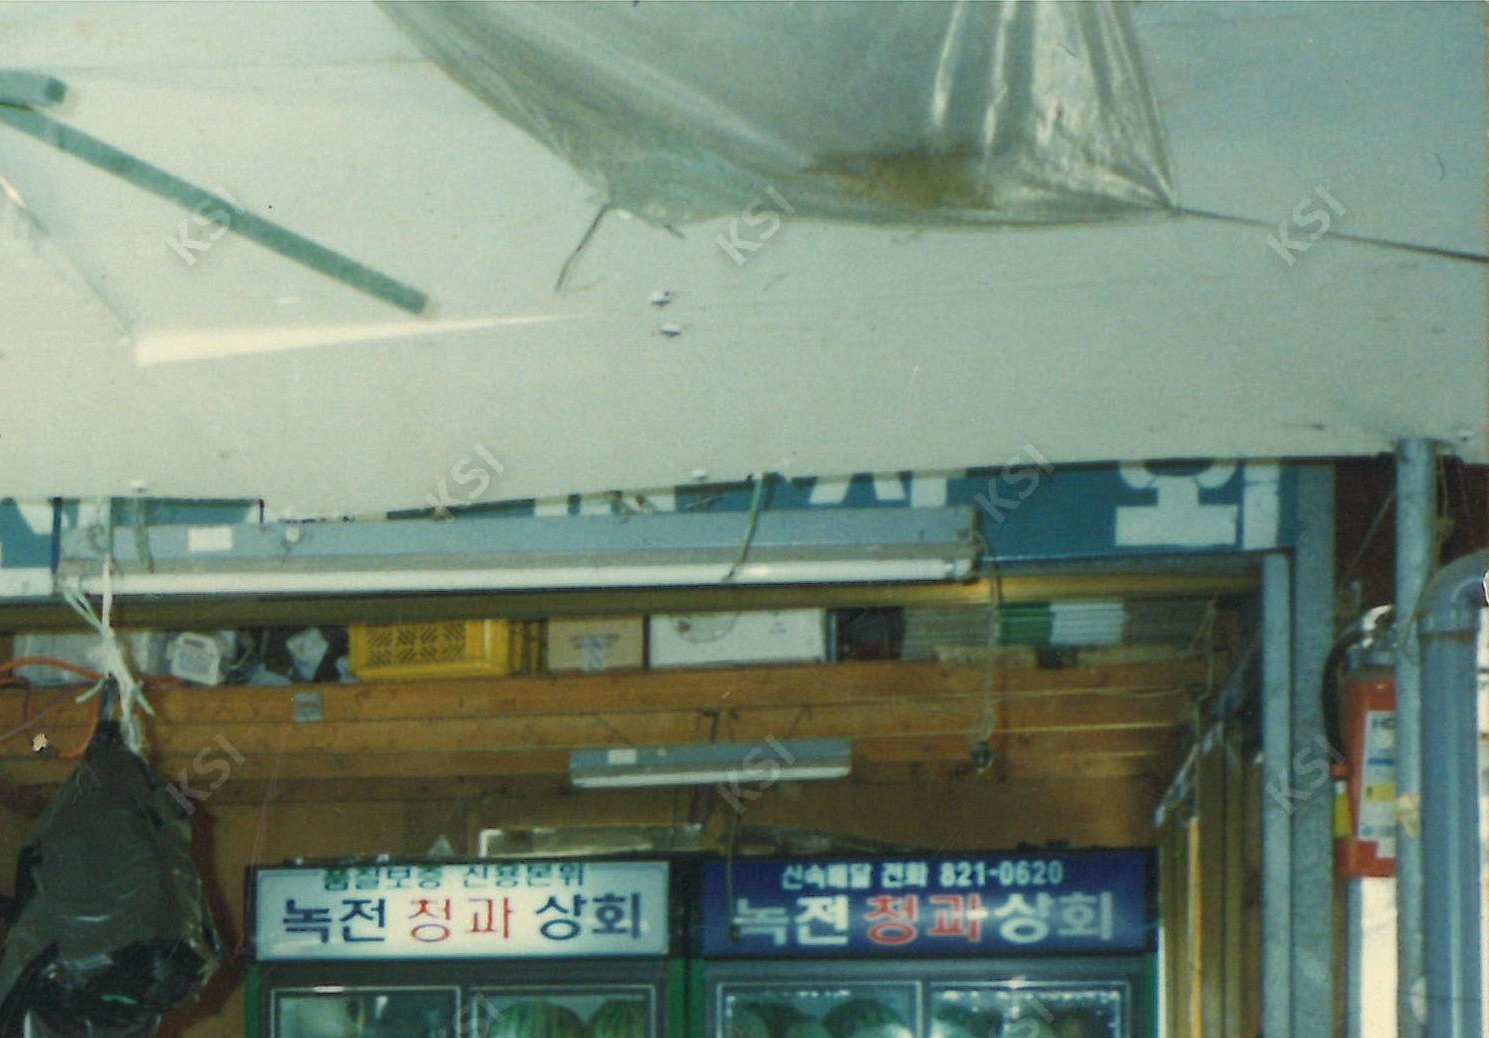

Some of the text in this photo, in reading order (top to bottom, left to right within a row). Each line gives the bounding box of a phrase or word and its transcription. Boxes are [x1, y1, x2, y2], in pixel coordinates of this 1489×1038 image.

[781, 860, 1065, 890] 신속배달 전화 821-0620
[282, 898, 386, 943] 녹전
[535, 893, 643, 941] 상회
[733, 892, 1111, 945] 녹전 청과 상회
